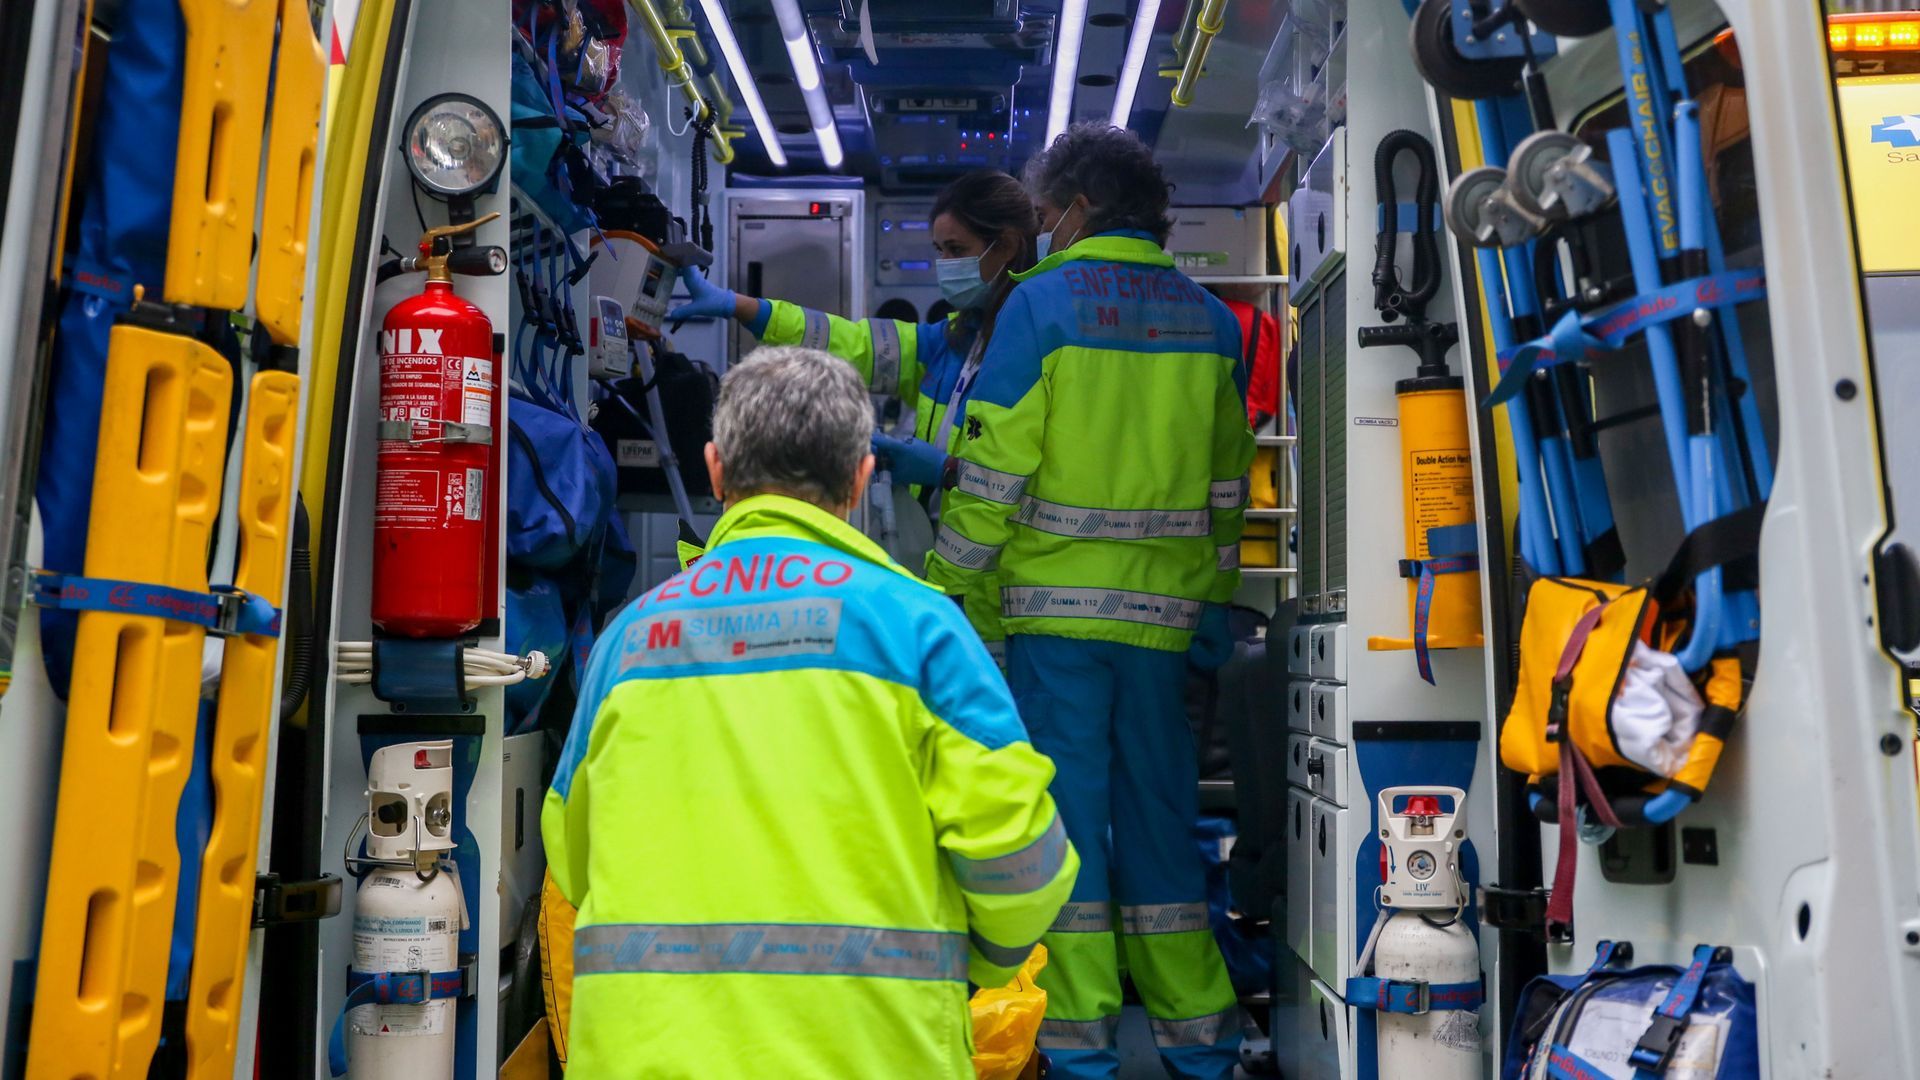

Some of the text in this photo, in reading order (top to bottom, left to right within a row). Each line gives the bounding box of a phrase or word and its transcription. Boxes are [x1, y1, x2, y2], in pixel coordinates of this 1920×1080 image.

[1096, 306, 1119, 327] M
[396, 357, 437, 365] INCENDIOS
[448, 359, 461, 369] CE
[422, 408, 429, 416] C
[1416, 456, 1436, 465] Double
[1437, 455, 1457, 464] Action
[964, 473, 1006, 492] SUMMA 112
[1037, 511, 1079, 526] SUMMA 112
[1103, 520, 1131, 529] SUMMA
[950, 544, 962, 555] 112
[1050, 598, 1098, 607] SUMMA 112
[647, 607, 829, 651] M SUMMA 112
